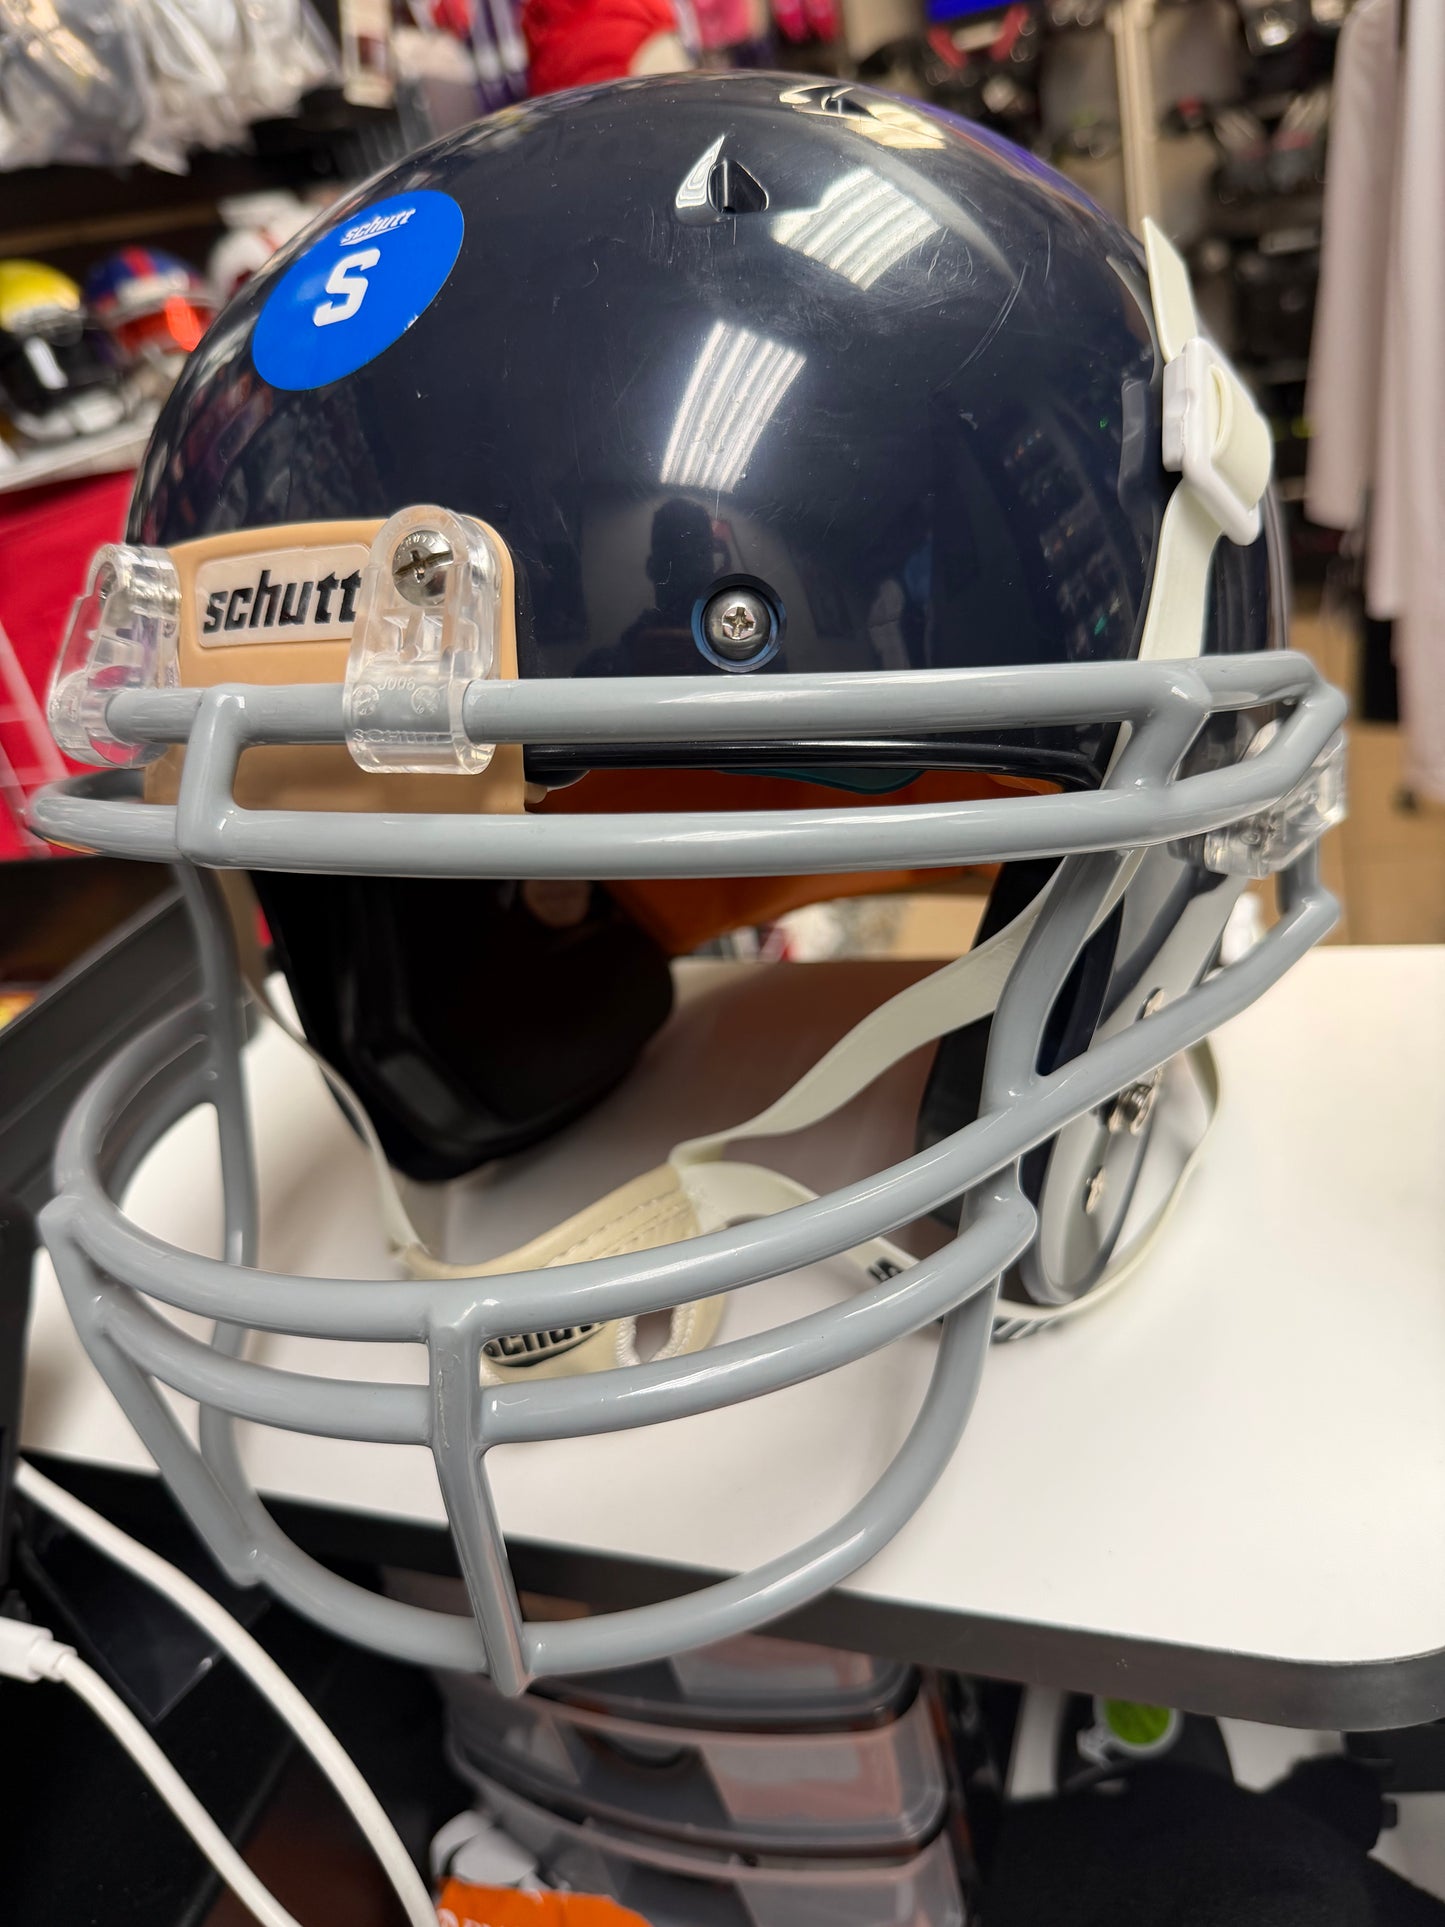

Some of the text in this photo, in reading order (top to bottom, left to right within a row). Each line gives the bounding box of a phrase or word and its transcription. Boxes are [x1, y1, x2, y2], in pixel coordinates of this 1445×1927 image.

[341, 208, 416, 245] schutt
[313, 248, 380, 327] S
[203, 569, 362, 634] schutt
